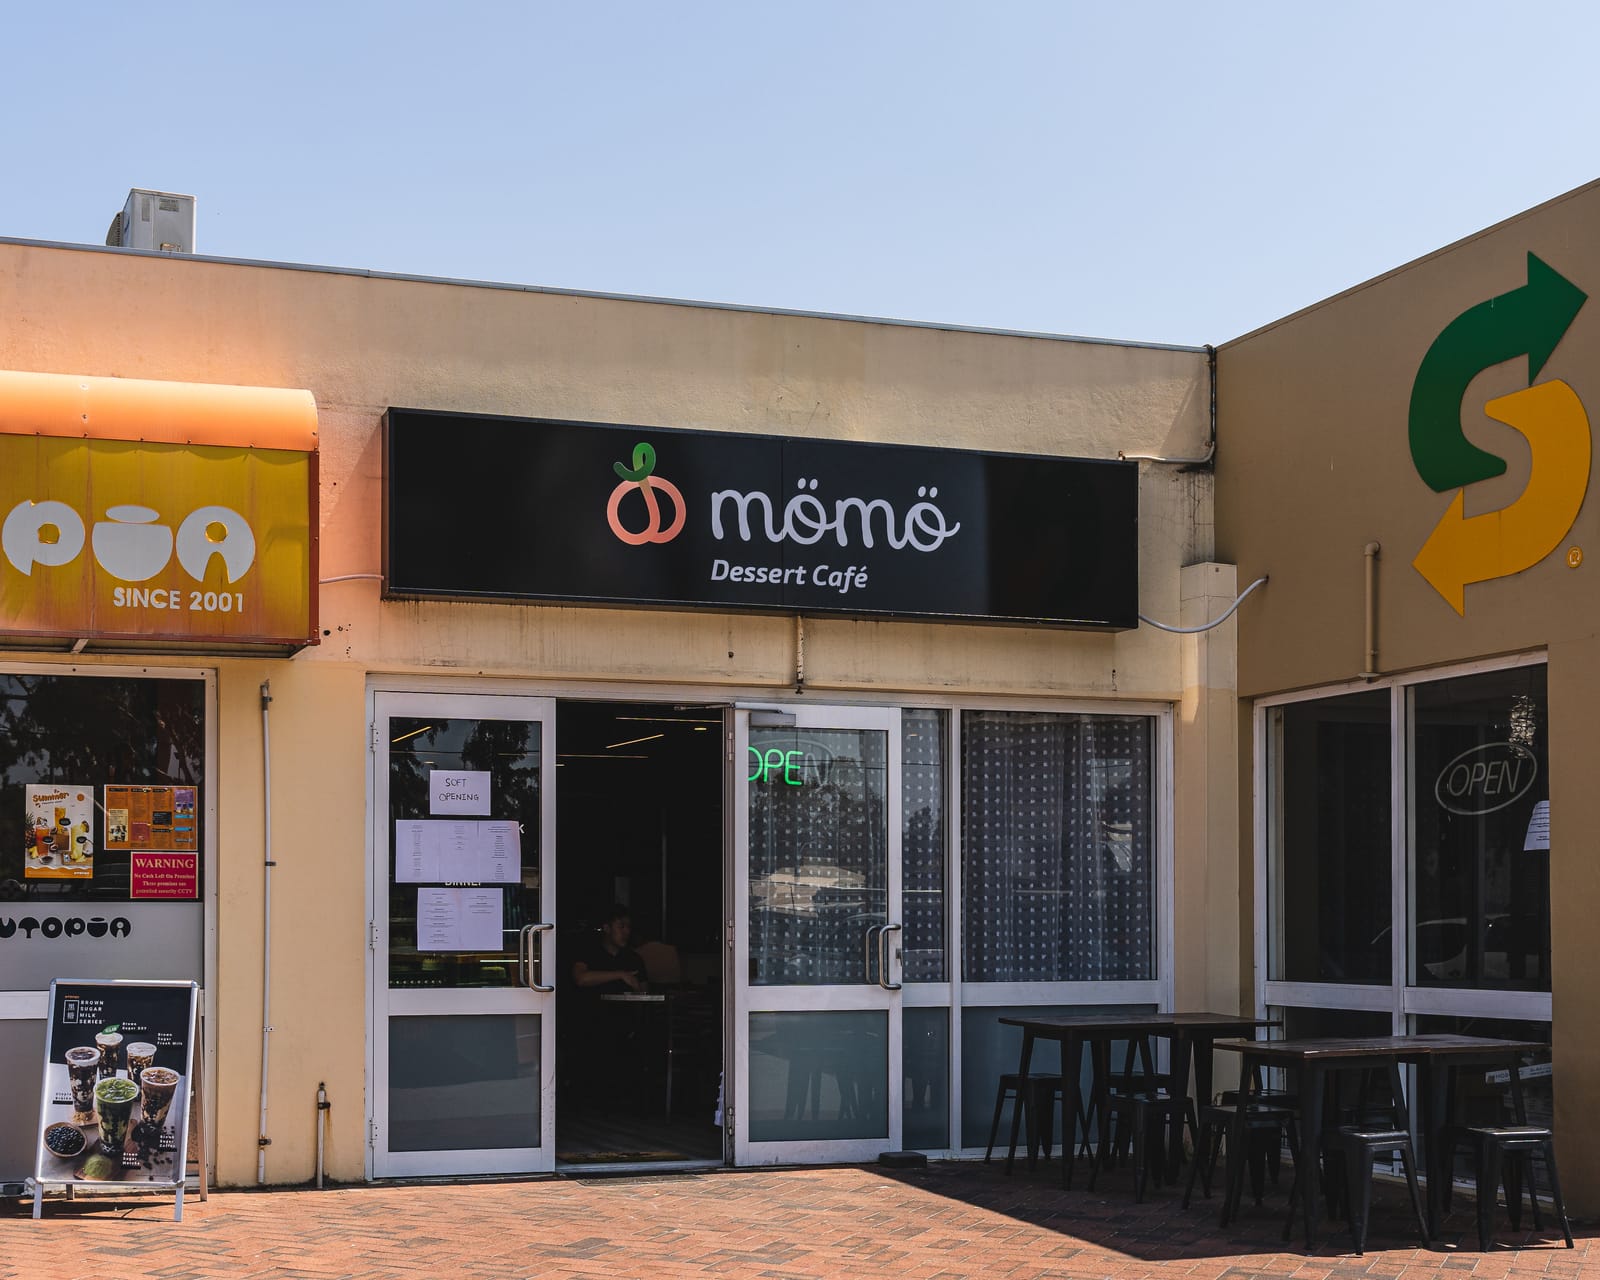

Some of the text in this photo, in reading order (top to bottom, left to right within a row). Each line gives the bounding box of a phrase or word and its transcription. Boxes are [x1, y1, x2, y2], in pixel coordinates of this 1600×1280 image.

[711, 559, 869, 594] Dessert Café
[113, 586, 244, 613] SINCE 2001
[445, 777, 468, 787] SOFT
[1450, 760, 1521, 796] OPEN
[438, 792, 480, 801] OPENING
[135, 858, 195, 869] WARNING
